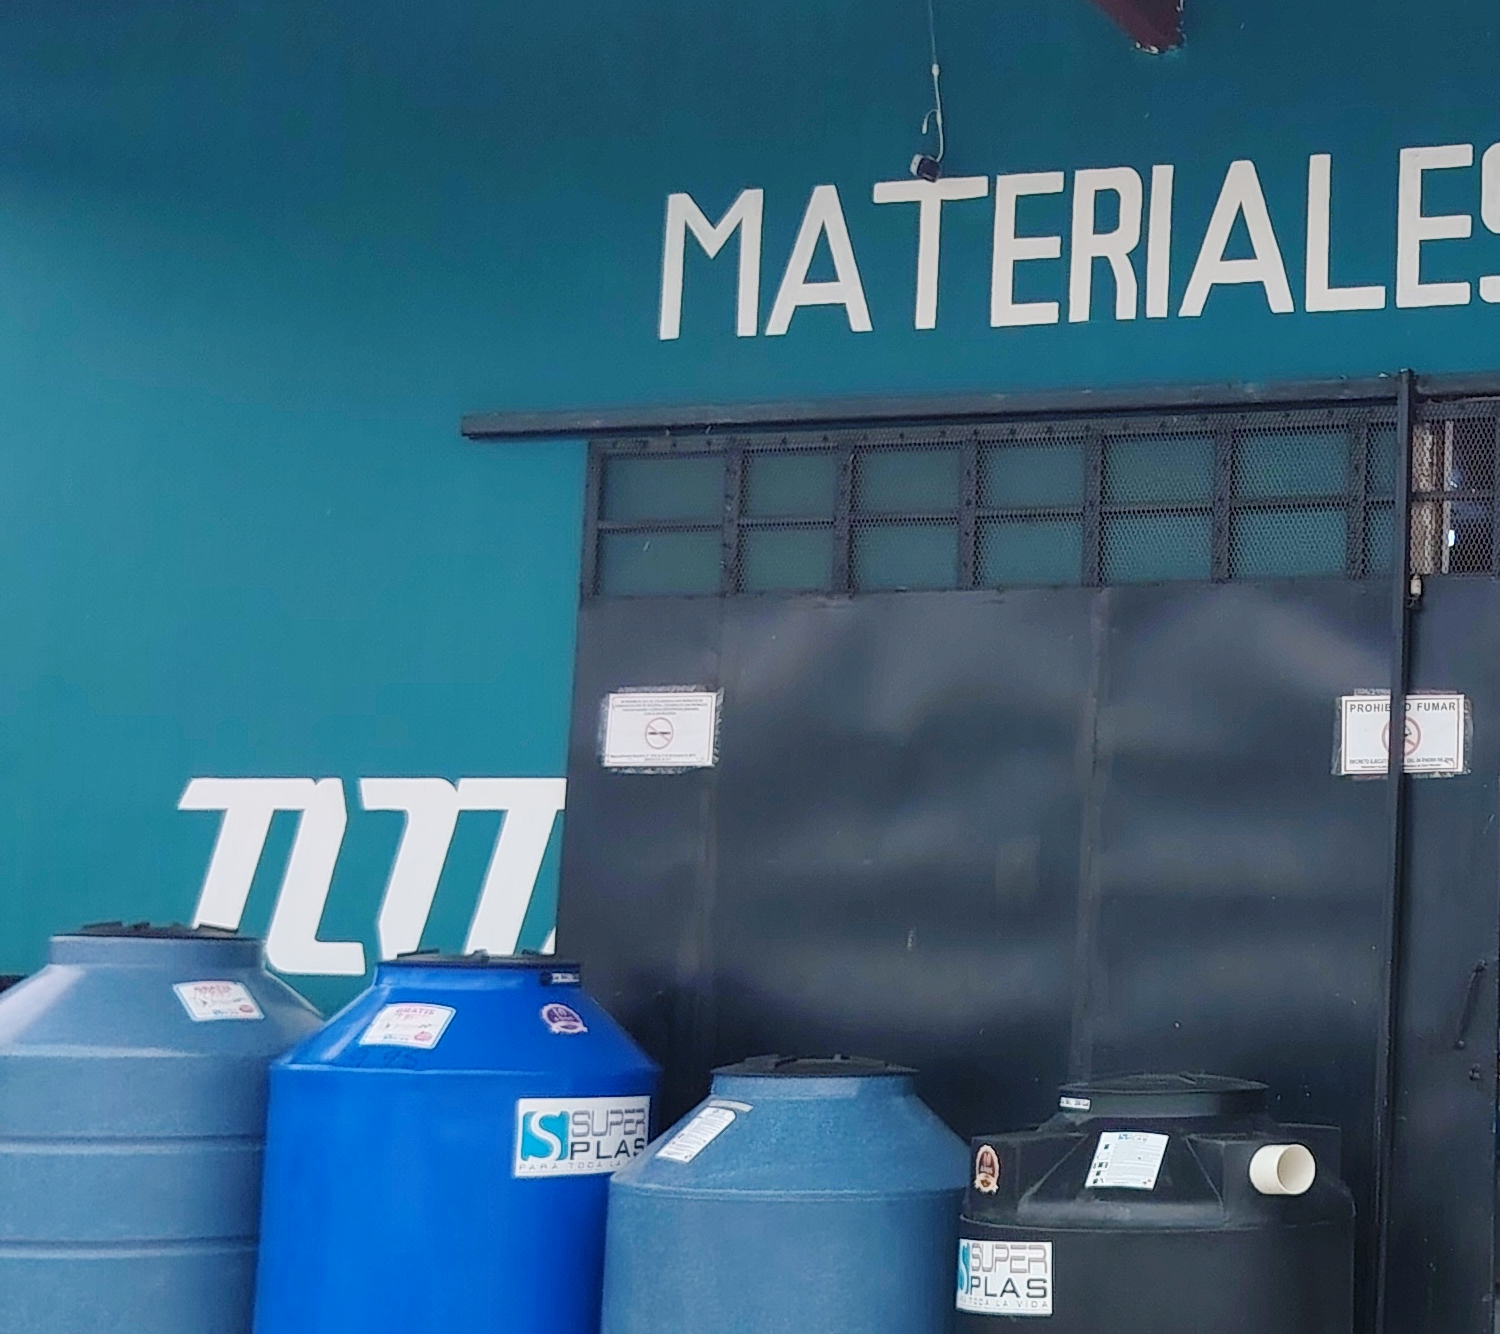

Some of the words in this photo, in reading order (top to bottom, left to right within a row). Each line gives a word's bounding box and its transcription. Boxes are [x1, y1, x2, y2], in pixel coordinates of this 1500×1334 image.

[1349, 702, 1412, 713] PROHIBO
[1417, 701, 1456, 712] FUMAR
[571, 1107, 646, 1138] SUPER
[569, 1138, 646, 1161] PLAS
[971, 1242, 1048, 1274] SUPER
[970, 1275, 1048, 1299] PLAS
[1016, 1300, 1049, 1308] VIDA
